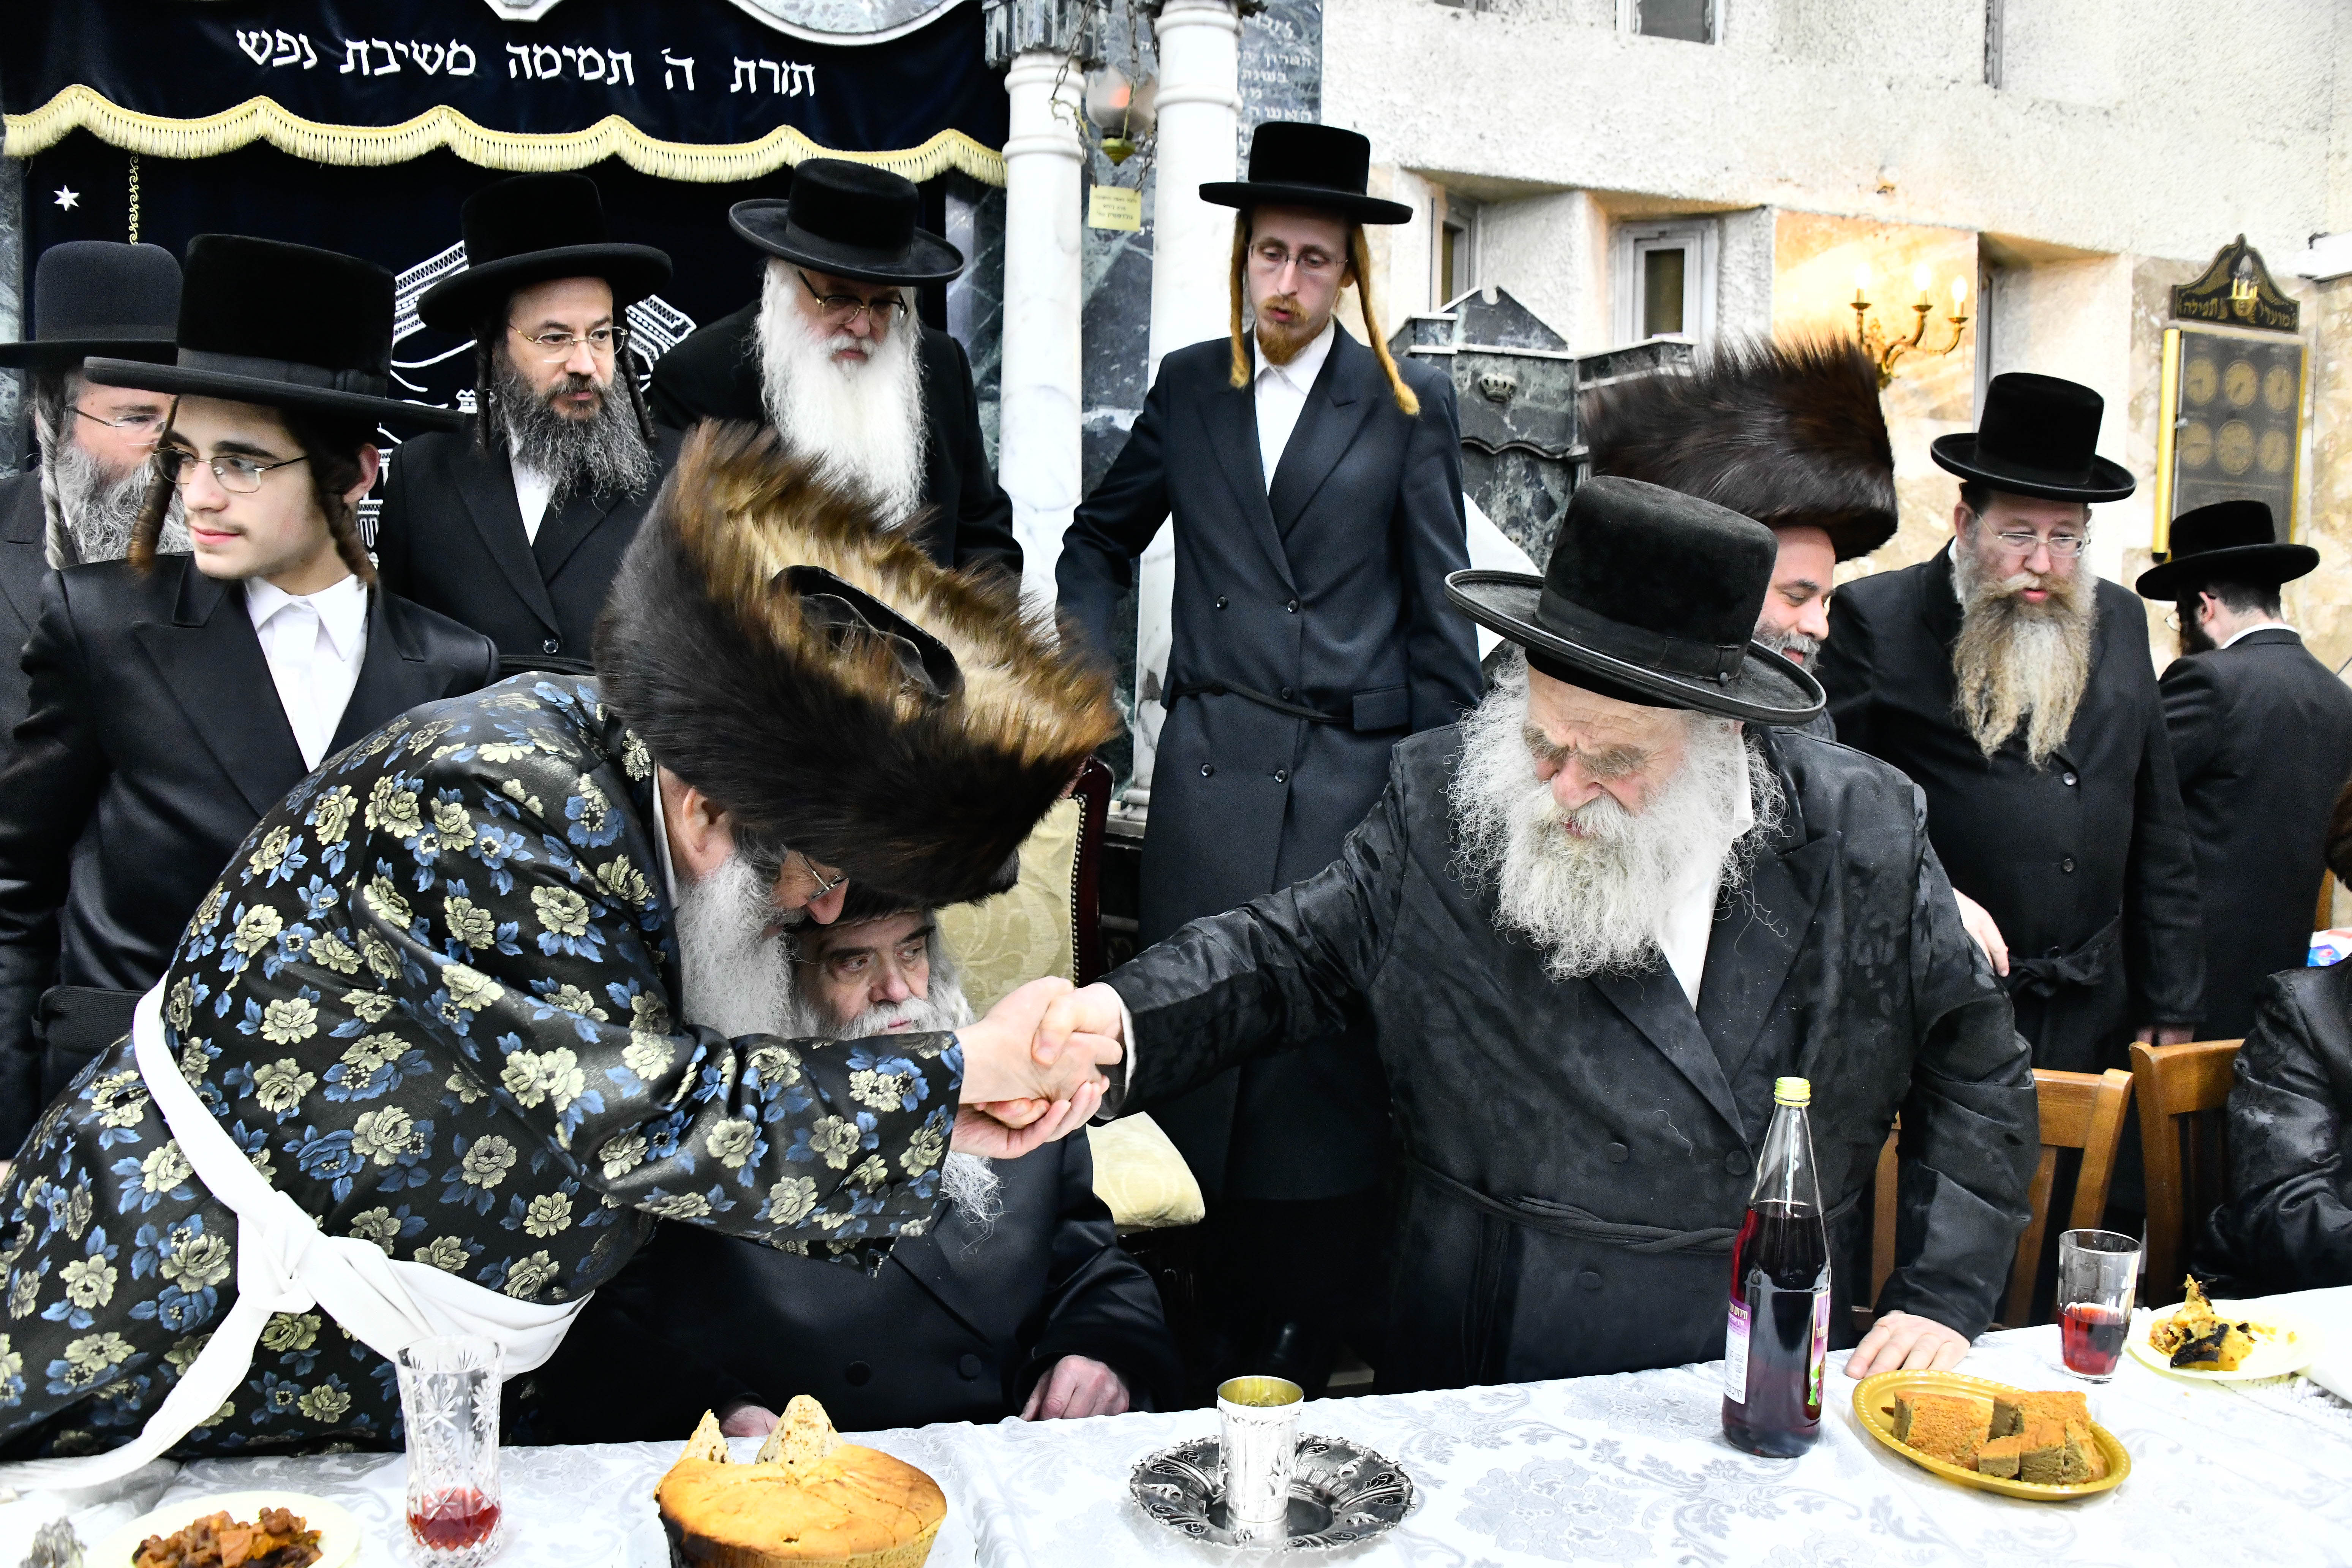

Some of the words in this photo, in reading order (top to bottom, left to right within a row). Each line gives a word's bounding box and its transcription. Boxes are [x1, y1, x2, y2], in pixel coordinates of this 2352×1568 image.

[236, 29, 318, 70] נפש
[339, 37, 476, 76] משיבת
[505, 42, 635, 86] תמימה
[1264, 53, 1311, 68] הארון
[730, 56, 815, 97] תורת
[1241, 69, 1289, 83] בשנת
[1734, 1306, 1748, 1320] תירוש
